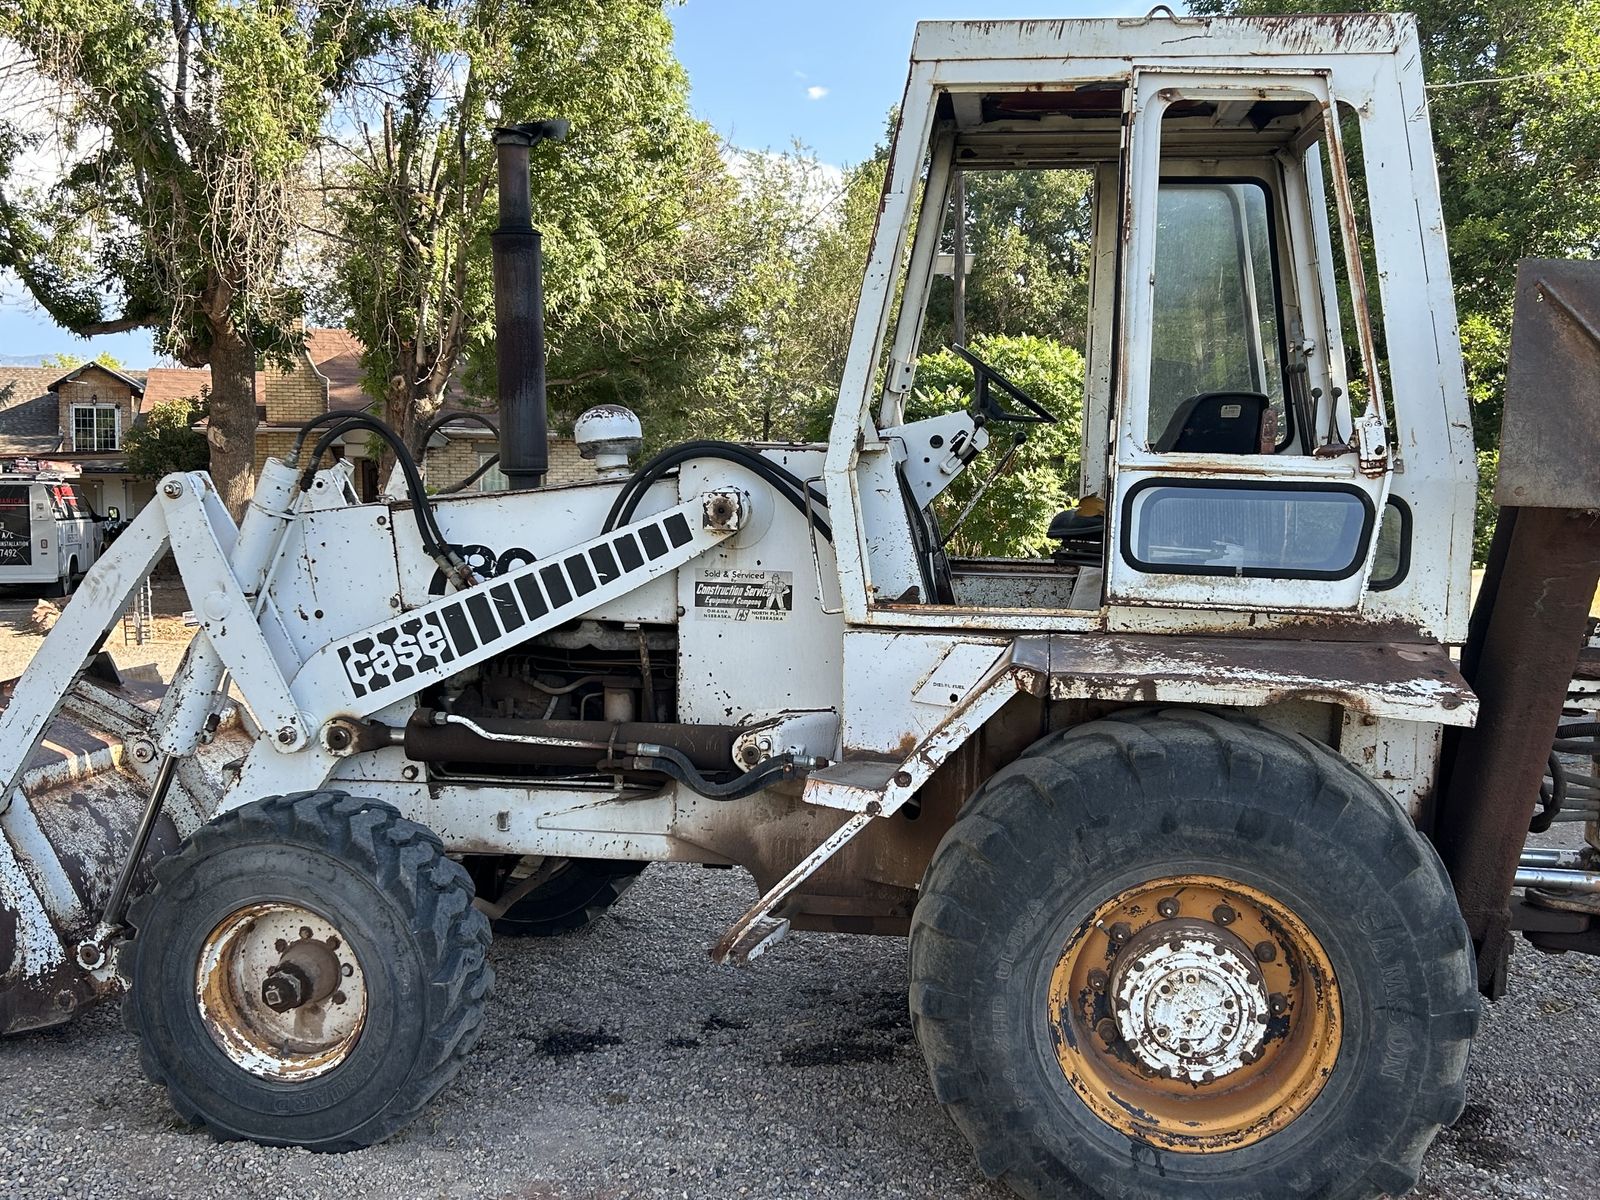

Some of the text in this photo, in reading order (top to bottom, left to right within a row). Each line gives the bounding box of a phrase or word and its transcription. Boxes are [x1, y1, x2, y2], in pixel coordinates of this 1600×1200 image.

[0, 548, 17, 557] 7492
[704, 569, 765, 579] Sold & Serviced
[696, 583, 772, 597] Construction Service
[704, 596, 762, 608] Equipment Company
